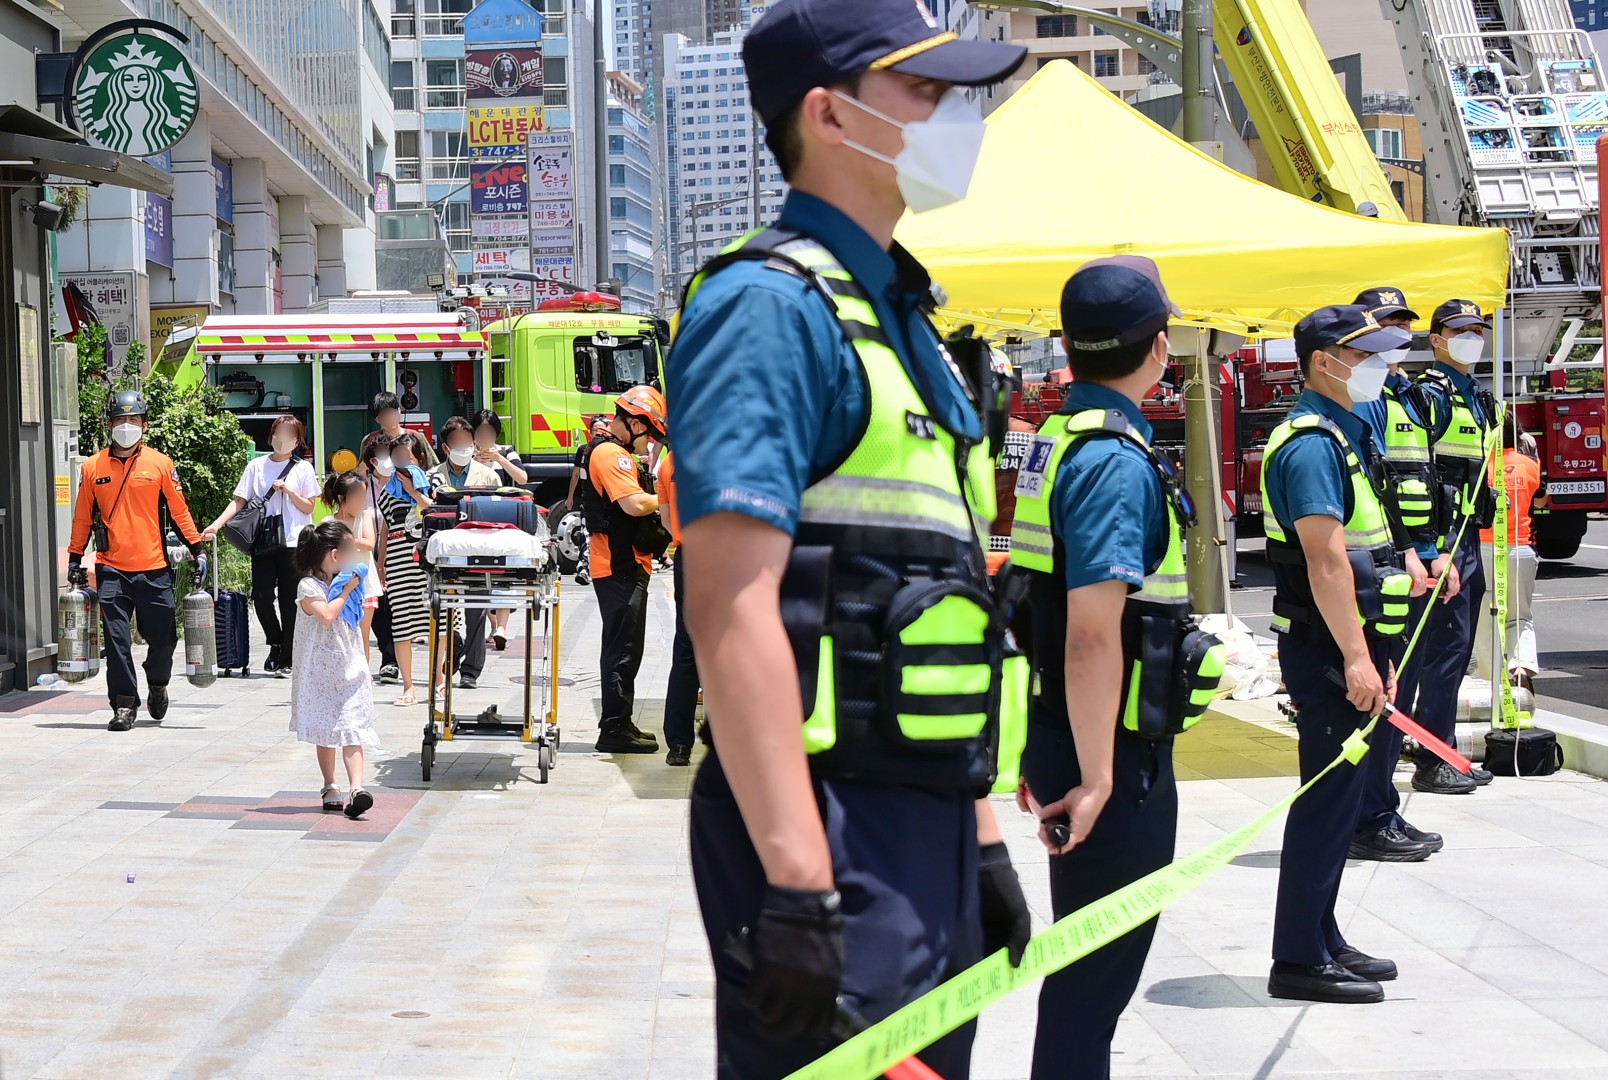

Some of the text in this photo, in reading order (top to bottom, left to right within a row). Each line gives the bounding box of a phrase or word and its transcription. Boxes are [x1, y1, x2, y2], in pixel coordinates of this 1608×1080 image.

[521, 58, 540, 71] 게임
[531, 135, 569, 144] 크리스탈비치
[1294, 149, 1312, 178] SKYLIFT
[1299, 144, 1316, 175] BRONTO
[484, 184, 521, 199] 포시즌
[481, 202, 528, 212] 로비층 747-
[534, 210, 570, 220] 미용실
[475, 251, 508, 264] 세탁
[97, 288, 127, 305] 혜택!
[157, 316, 191, 325] MONEY
[1075, 340, 1117, 350] POLICE
[1563, 459, 1596, 468] 우동고가
[1577, 482, 1600, 492] 8351
